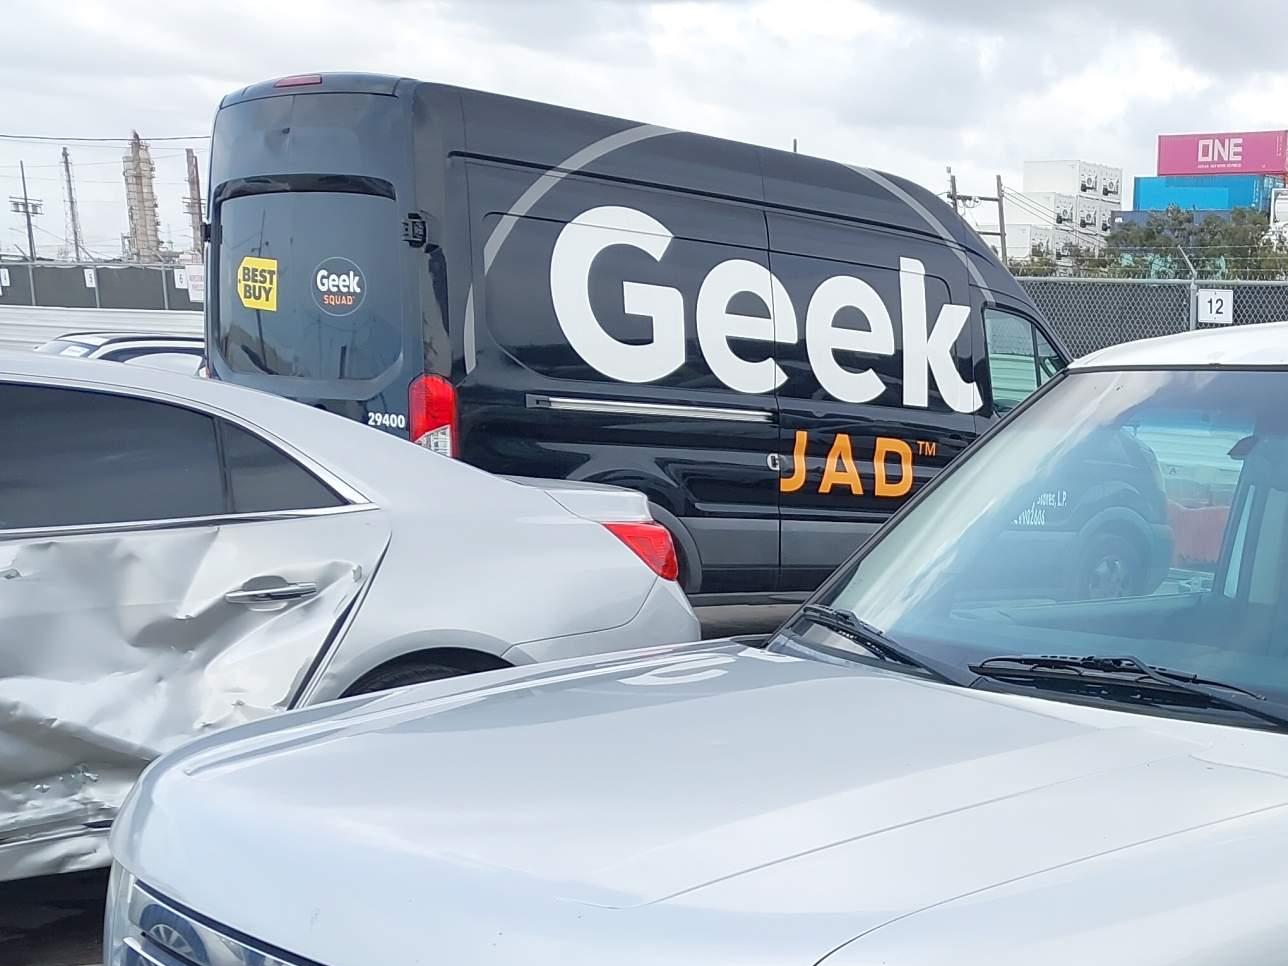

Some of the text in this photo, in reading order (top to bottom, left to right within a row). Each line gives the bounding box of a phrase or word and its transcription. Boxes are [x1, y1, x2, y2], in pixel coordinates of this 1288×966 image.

[1198, 138, 1243, 162] ONE
[242, 266, 276, 286] BEST
[316, 269, 361, 293] Geek
[243, 283, 273, 302] BUY
[323, 294, 353, 305] SQUAD
[550, 205, 983, 414] Geek
[1207, 297, 1224, 315] 12
[367, 411, 406, 428] 29400
